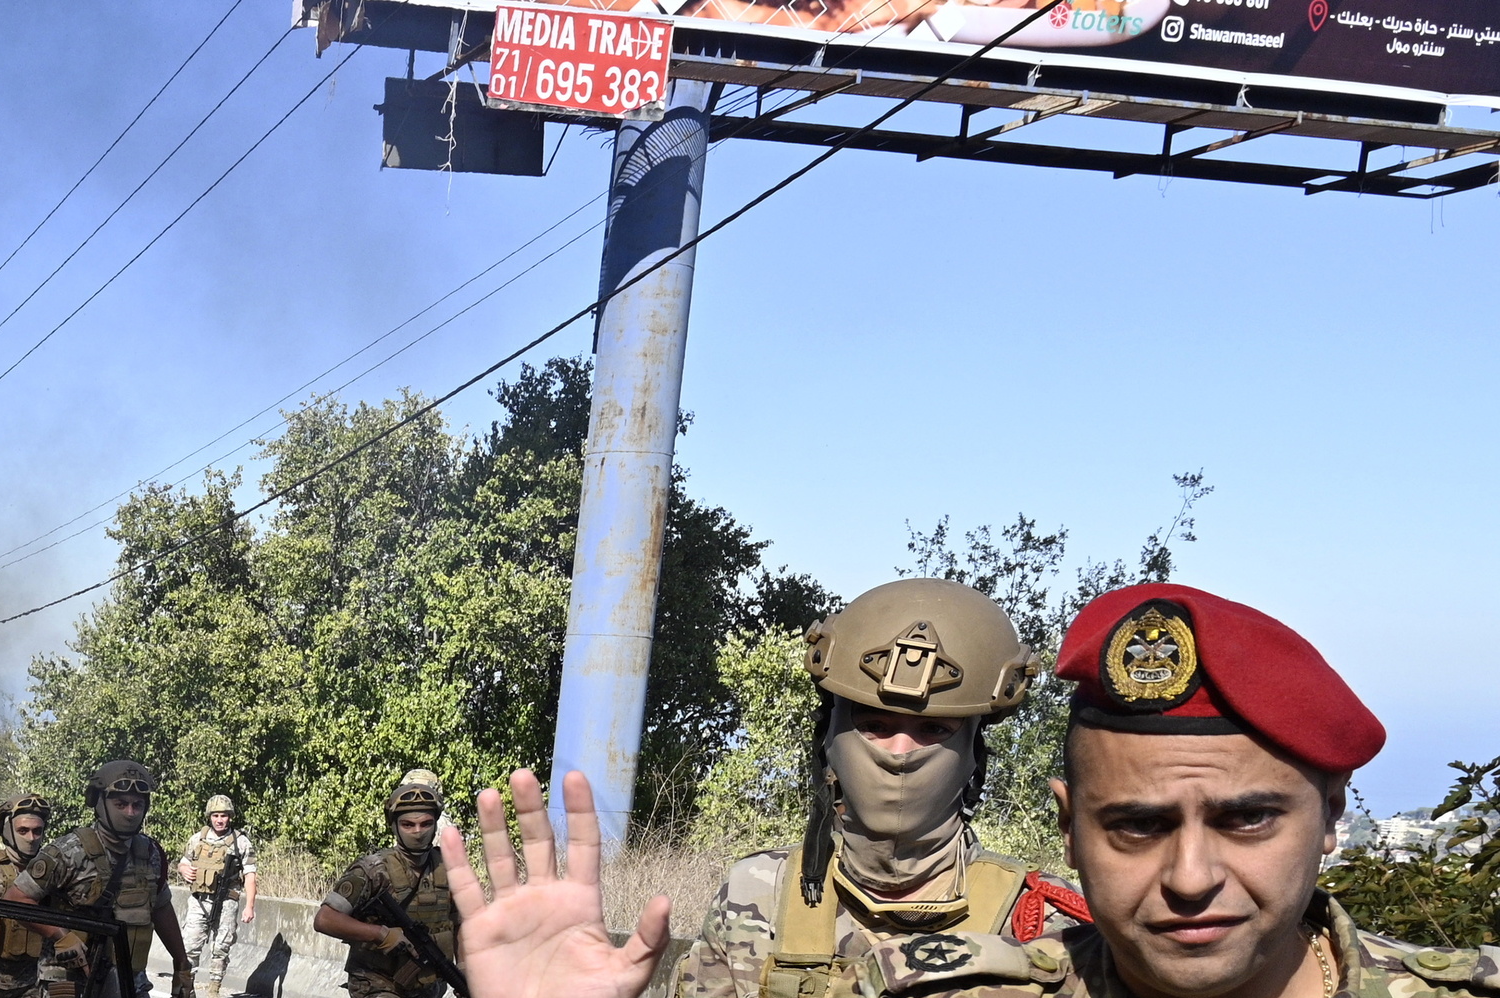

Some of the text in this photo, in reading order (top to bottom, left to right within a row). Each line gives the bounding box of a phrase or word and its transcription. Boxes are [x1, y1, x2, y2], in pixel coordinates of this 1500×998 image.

[1071, 8, 1143, 35] toters
[1337, 11, 1374, 31] بعلبك
[1382, 16, 1413, 33] حريك
[1414, 18, 1438, 36] حارة
[1446, 24, 1474, 39] سنتر
[497, 8, 665, 60] MEDIA TRADE
[1189, 23, 1285, 48] Shawarmaaseel
[495, 47, 521, 72] 71
[1386, 38, 1445, 57] سنترو مول
[491, 74, 517, 98] 01
[536, 59, 595, 104] 695
[602, 66, 660, 109] 383
